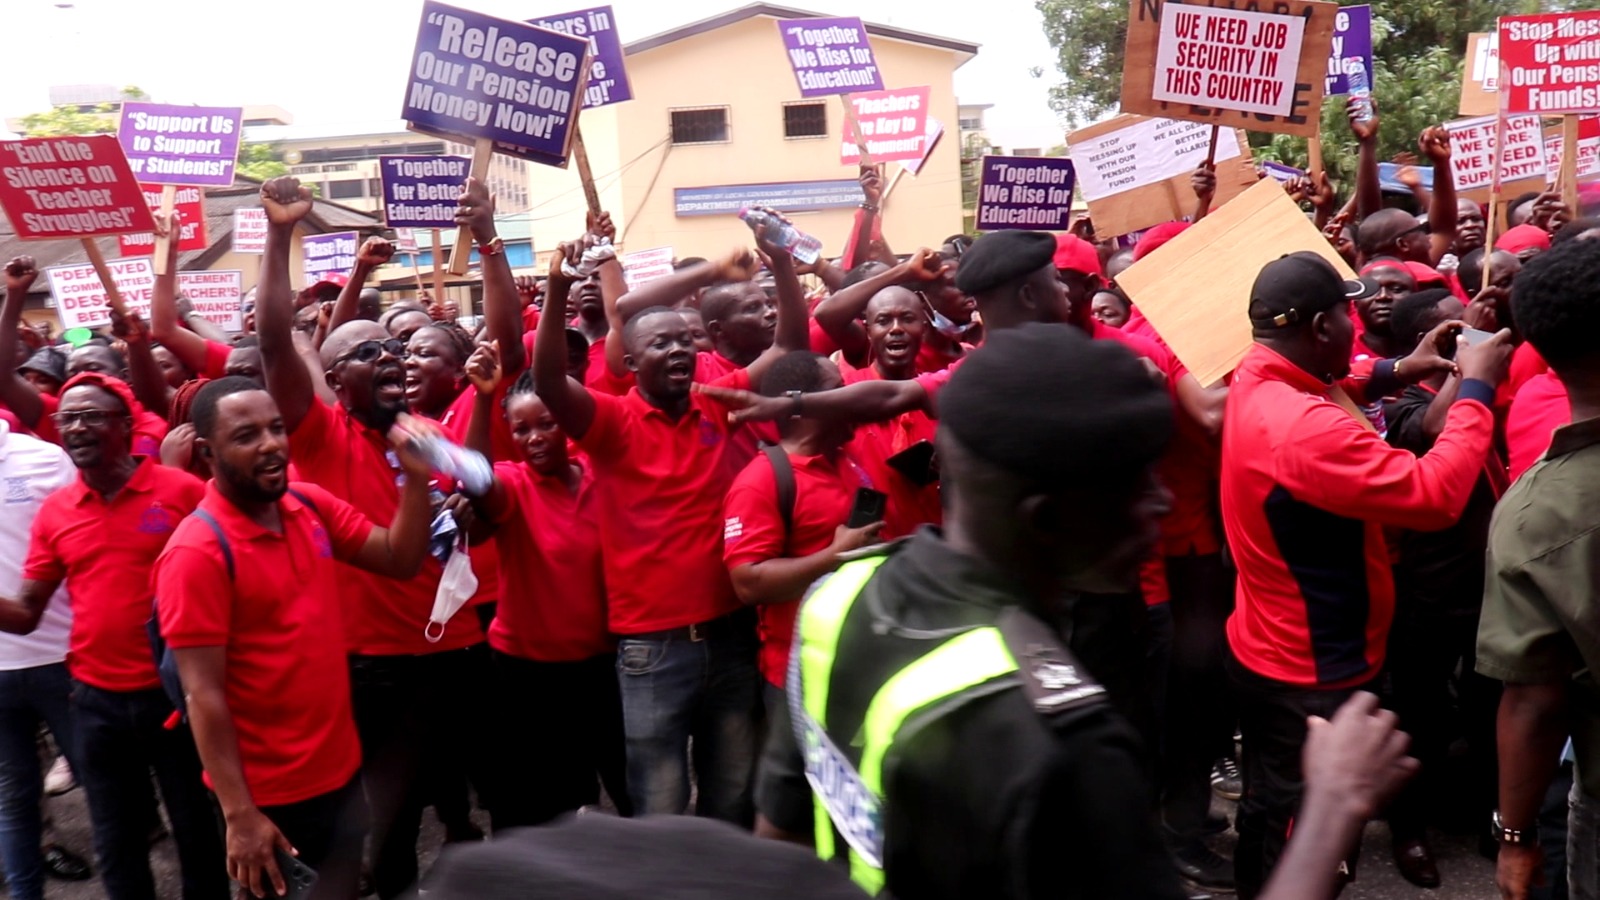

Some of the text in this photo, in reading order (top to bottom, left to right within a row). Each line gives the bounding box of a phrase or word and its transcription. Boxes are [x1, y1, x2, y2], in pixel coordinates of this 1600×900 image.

[587, 12, 610, 32] in
[1175, 12, 1201, 40] WE
[1205, 16, 1248, 45] NEED
[1252, 22, 1288, 49] JOB
[1501, 18, 1600, 41] “Stop Mes
[787, 26, 860, 46] “Together
[427, 12, 577, 82] “Release
[789, 46, 871, 68] We Rise for
[1534, 43, 1560, 64] Up
[1176, 41, 1278, 77] SECURITY IN
[416, 51, 464, 86] Our
[466, 64, 570, 113] Pension
[797, 66, 876, 90] Education!”
[1512, 67, 1547, 86] Our
[1550, 62, 1600, 84] Pens
[1166, 68, 1202, 96] THIS
[1207, 73, 1283, 106] COUNTRY
[408, 82, 565, 139] Money Now!”
[853, 95, 920, 115] “Teachers
[128, 112, 234, 134] “Support Us
[875, 117, 901, 135] Key
[902, 116, 916, 132] to
[133, 135, 221, 154] to Support
[1099, 137, 1120, 149] STOP
[1153, 132, 1166, 141] WE
[1168, 128, 1184, 137] ALL
[1175, 130, 1207, 145] BETTER
[4, 140, 94, 164] “End the
[1089, 143, 1137, 162] MESSING UP
[1174, 141, 1209, 156] SALARIE
[1460, 141, 1482, 153] WE
[128, 157, 232, 176] ur Students!”
[388, 159, 464, 178] “Together
[1096, 154, 1136, 171] WITH OUR
[1102, 164, 1136, 180] PENSION
[1455, 156, 1482, 171] WE
[3, 165, 118, 188] Silence on
[992, 164, 1068, 184] “Together
[1109, 176, 1136, 188] FUNDS
[25, 188, 113, 209] Teacher
[392, 183, 415, 200] for
[984, 185, 1070, 204] We Rise for
[677, 200, 740, 211] DEPARTMENT
[980, 205, 1068, 224] Education!”
[22, 206, 135, 232] Struggles!”
[178, 274, 235, 285] PLEMENT
